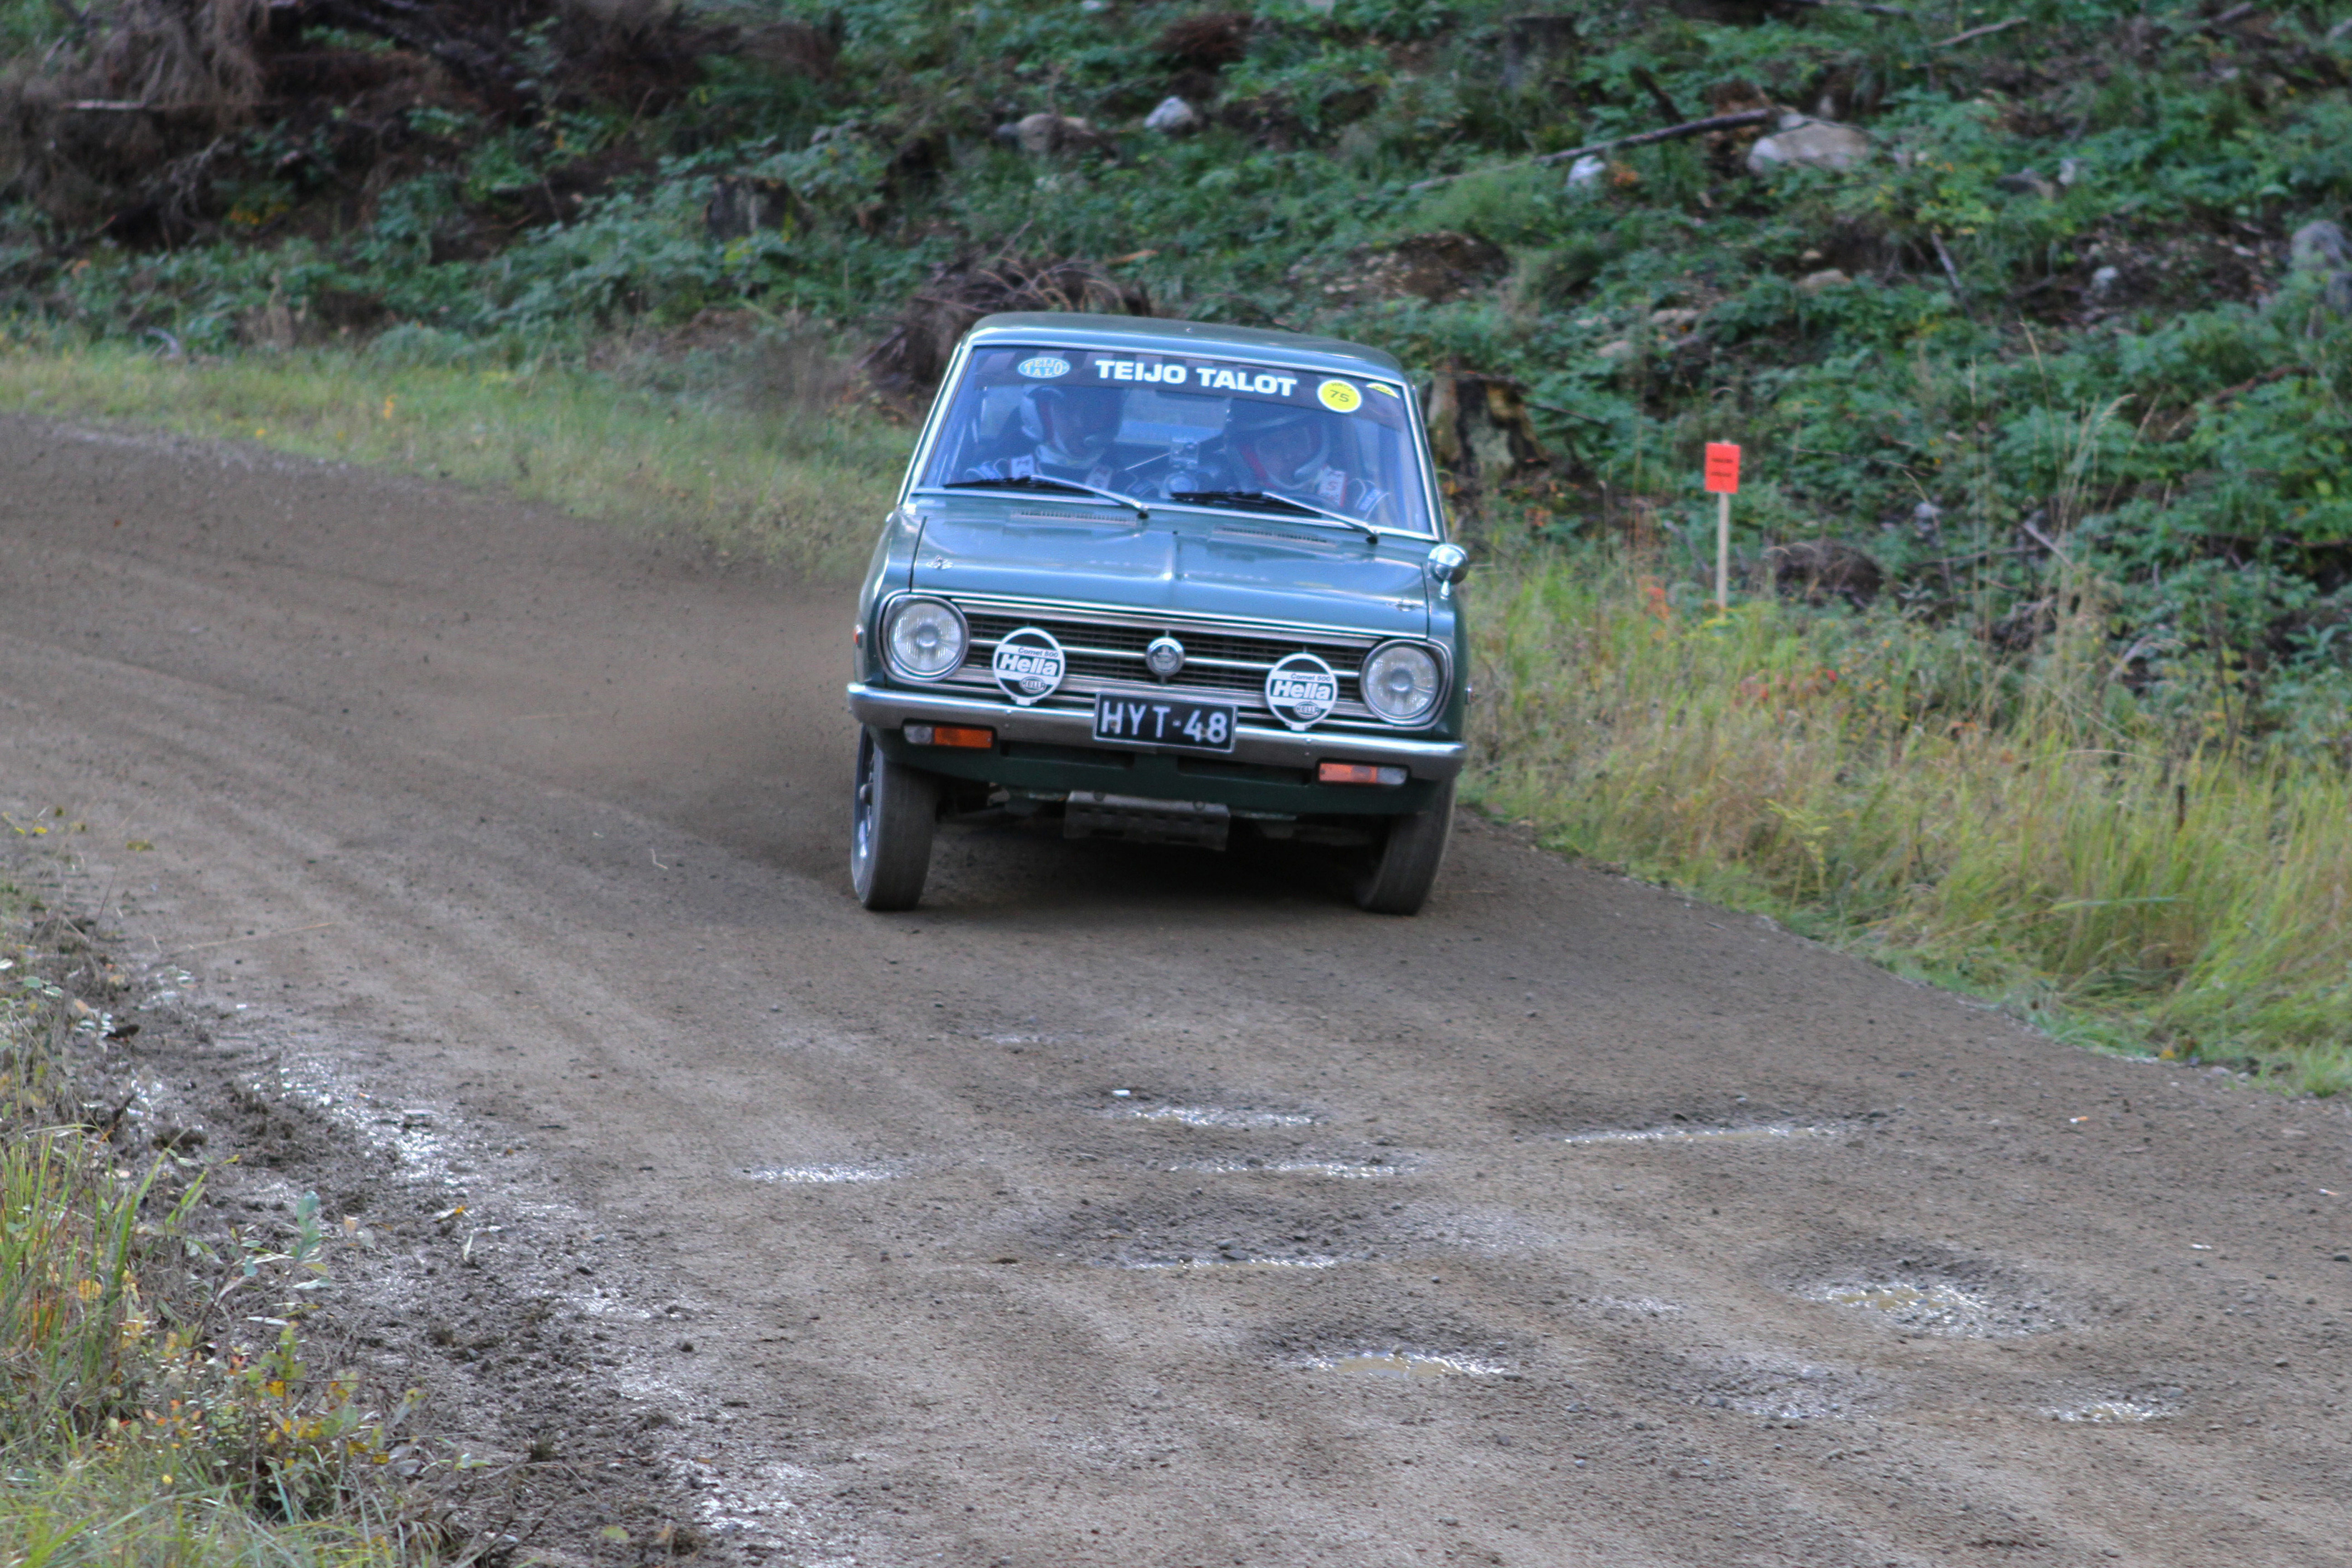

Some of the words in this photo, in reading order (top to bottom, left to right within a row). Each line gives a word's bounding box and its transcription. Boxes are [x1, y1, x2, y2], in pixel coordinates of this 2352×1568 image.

[1024, 359, 1063, 374] TEIJO
[1095, 360, 1186, 384] TEIJO
[1196, 368, 1297, 396] TALOT
[1330, 389, 1350, 402] 75
[1000, 653, 1058, 676] Hella
[1273, 680, 1331, 700] Hella
[1100, 700, 1228, 744] HYT-48
